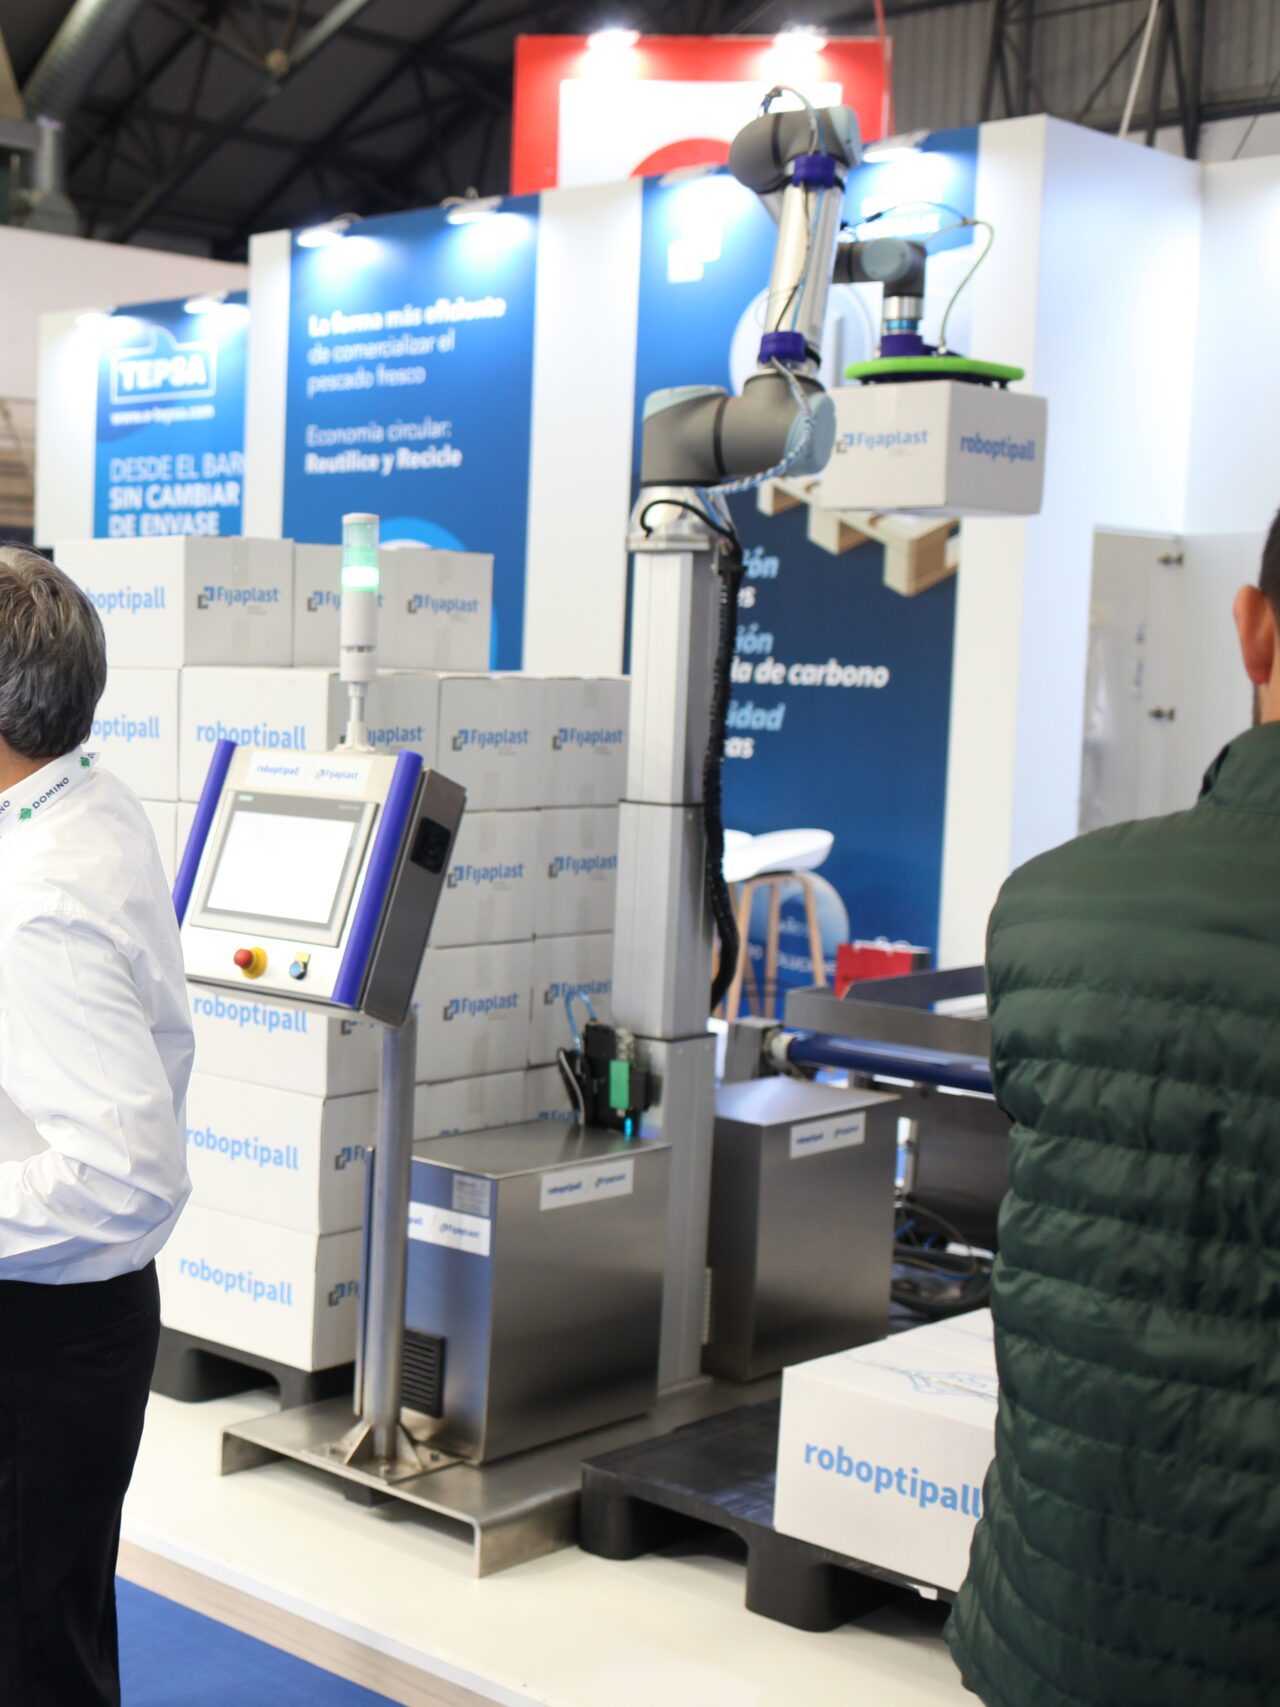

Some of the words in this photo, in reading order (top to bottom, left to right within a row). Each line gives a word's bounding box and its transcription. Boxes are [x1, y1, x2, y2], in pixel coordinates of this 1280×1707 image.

[308, 343, 330, 365] de
[437, 328, 456, 352] el
[119, 354, 207, 391] TEPSA
[307, 367, 374, 399] pescado
[376, 363, 426, 386] fresco
[381, 453, 395, 476] y
[396, 443, 463, 469] Recicle
[960, 432, 1036, 463] roboptipall
[110, 455, 173, 482] DESDE
[175, 453, 199, 479] EL
[109, 486, 143, 510] SIN
[145, 481, 240, 508] CAMBIAR
[109, 514, 137, 537] DE
[139, 511, 220, 536] ENVASE
[754, 656, 787, 685] de
[787, 658, 890, 688] carbono
[31, 776, 70, 810] DOMINO
[194, 995, 308, 1034] roboptipall
[186, 1126, 299, 1171] roboptipall
[180, 1256, 294, 1306] roboptipall
[803, 1442, 982, 1519] roboptipall
